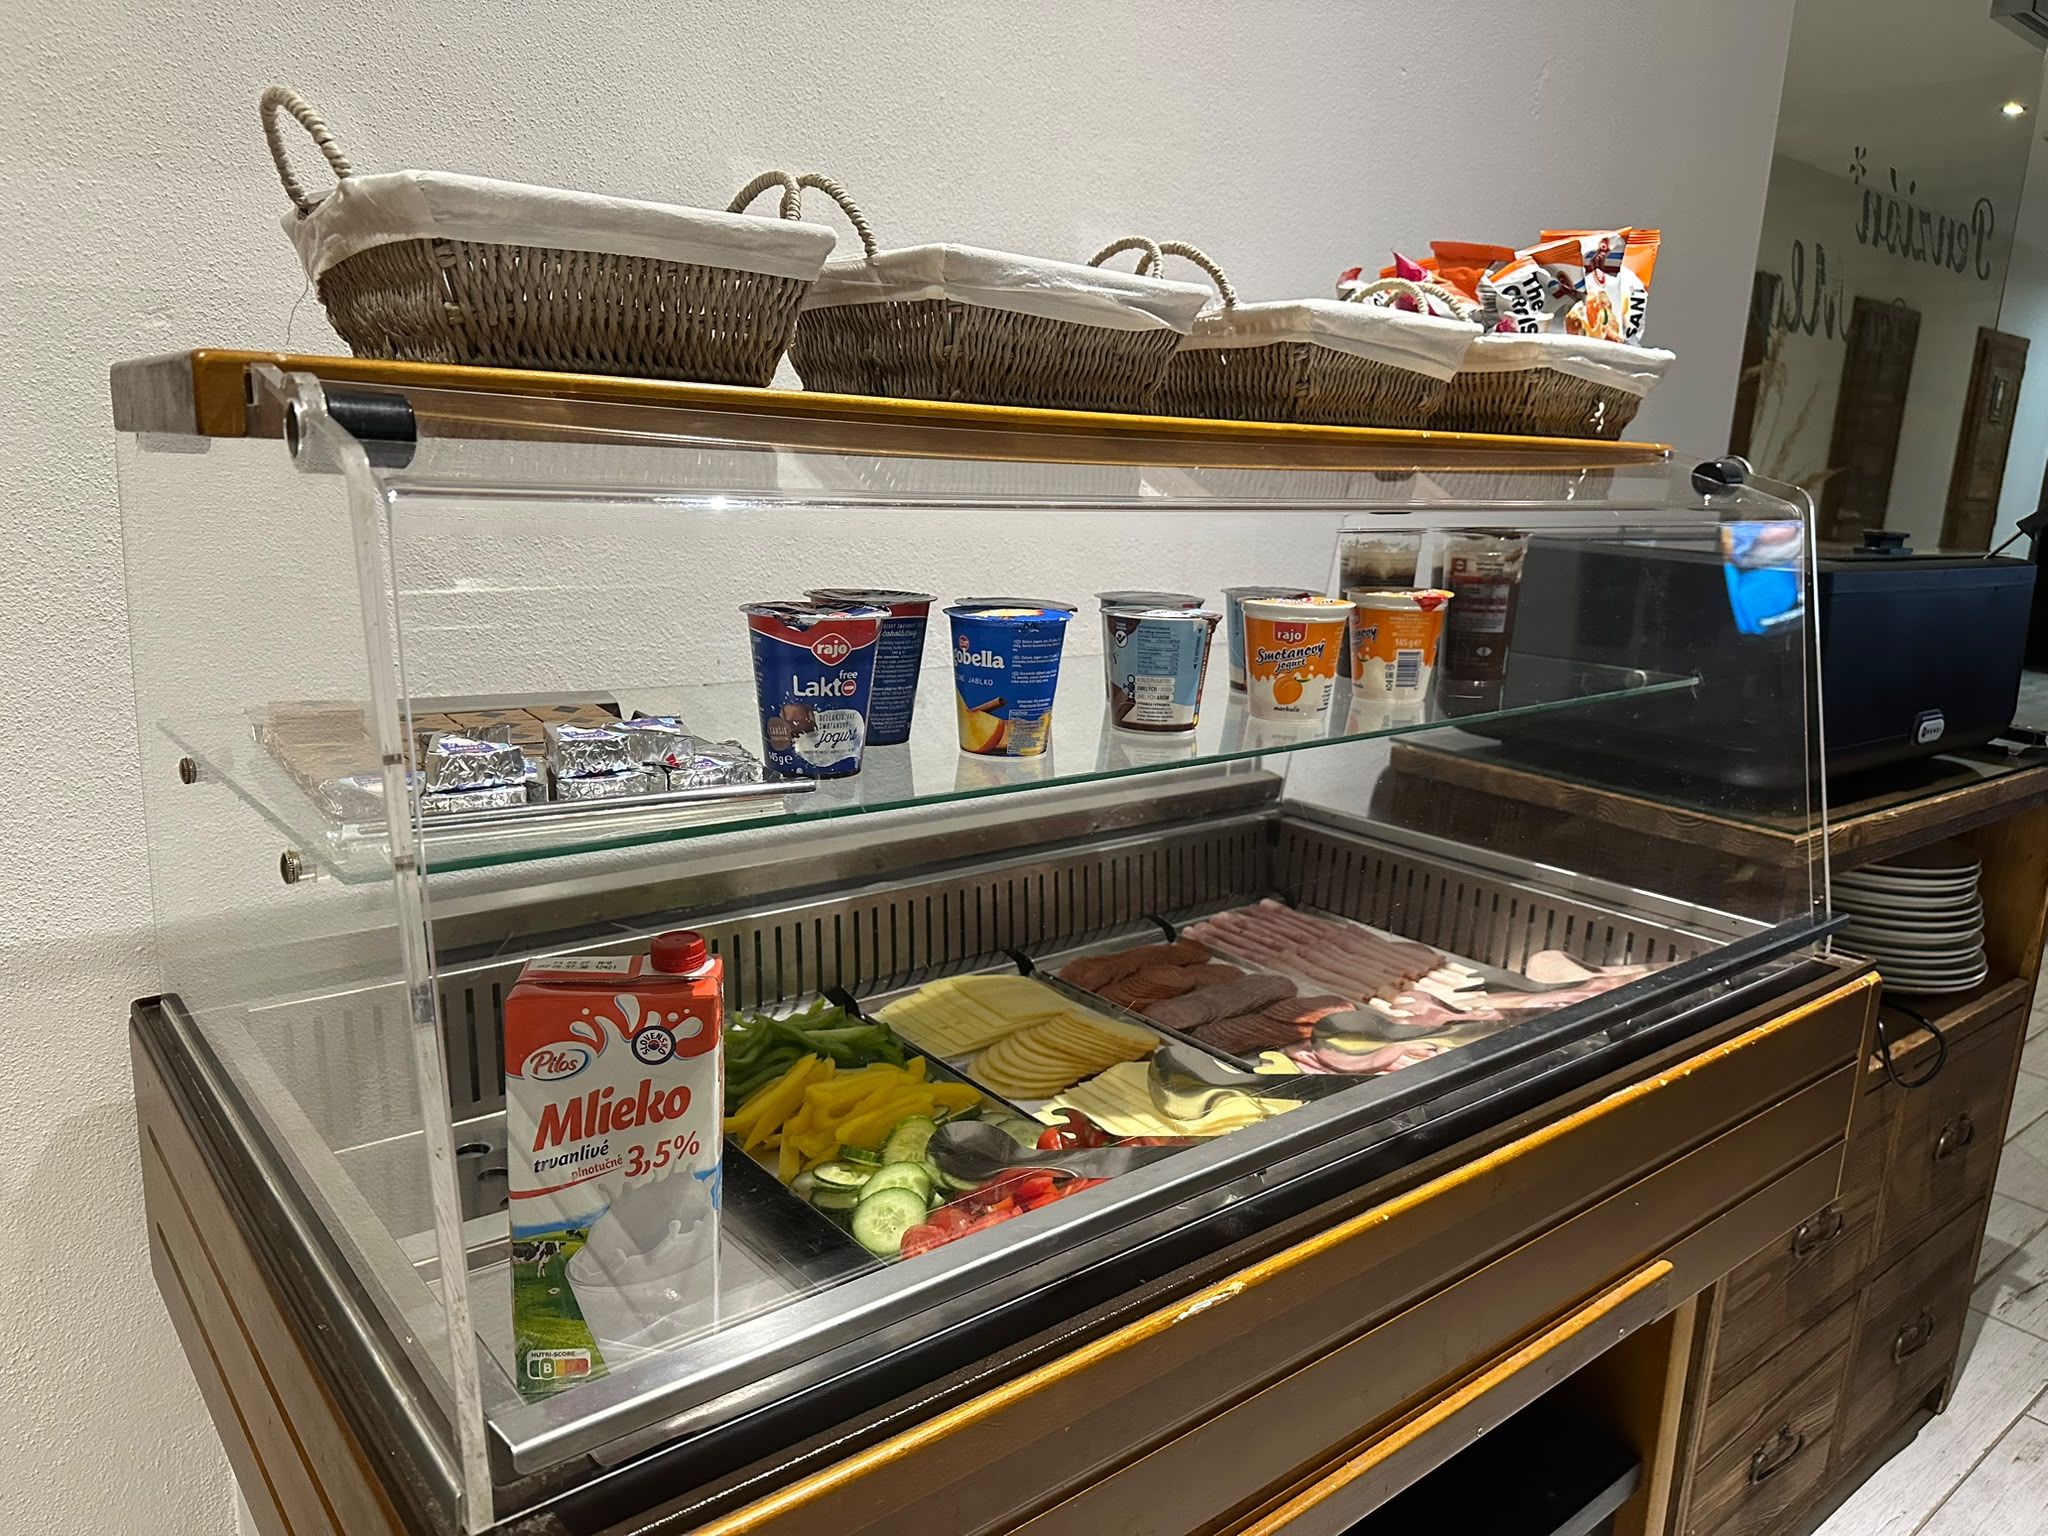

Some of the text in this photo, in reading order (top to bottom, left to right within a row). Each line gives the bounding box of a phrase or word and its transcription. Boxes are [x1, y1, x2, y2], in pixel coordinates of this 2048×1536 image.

[1521, 270, 1544, 313] The
[1277, 629, 1302, 644] rajo
[816, 640, 849, 659] rajo
[1256, 638, 1326, 664] Smotanový
[839, 670, 858, 680] free
[1274, 658, 1307, 674] jogurt
[968, 677, 994, 687] JABLKO
[814, 729, 857, 749] jogurt
[640, 1032, 667, 1056] SLOVENSKO
[530, 1051, 579, 1075] Pilos
[532, 1079, 692, 1152] Mlieko
[534, 1140, 609, 1174] trvanlivé
[571, 1130, 701, 1183] plnotučné 3,5%
[531, 1350, 576, 1359] NUTRI-SCORE
[543, 1362, 553, 1374] B
